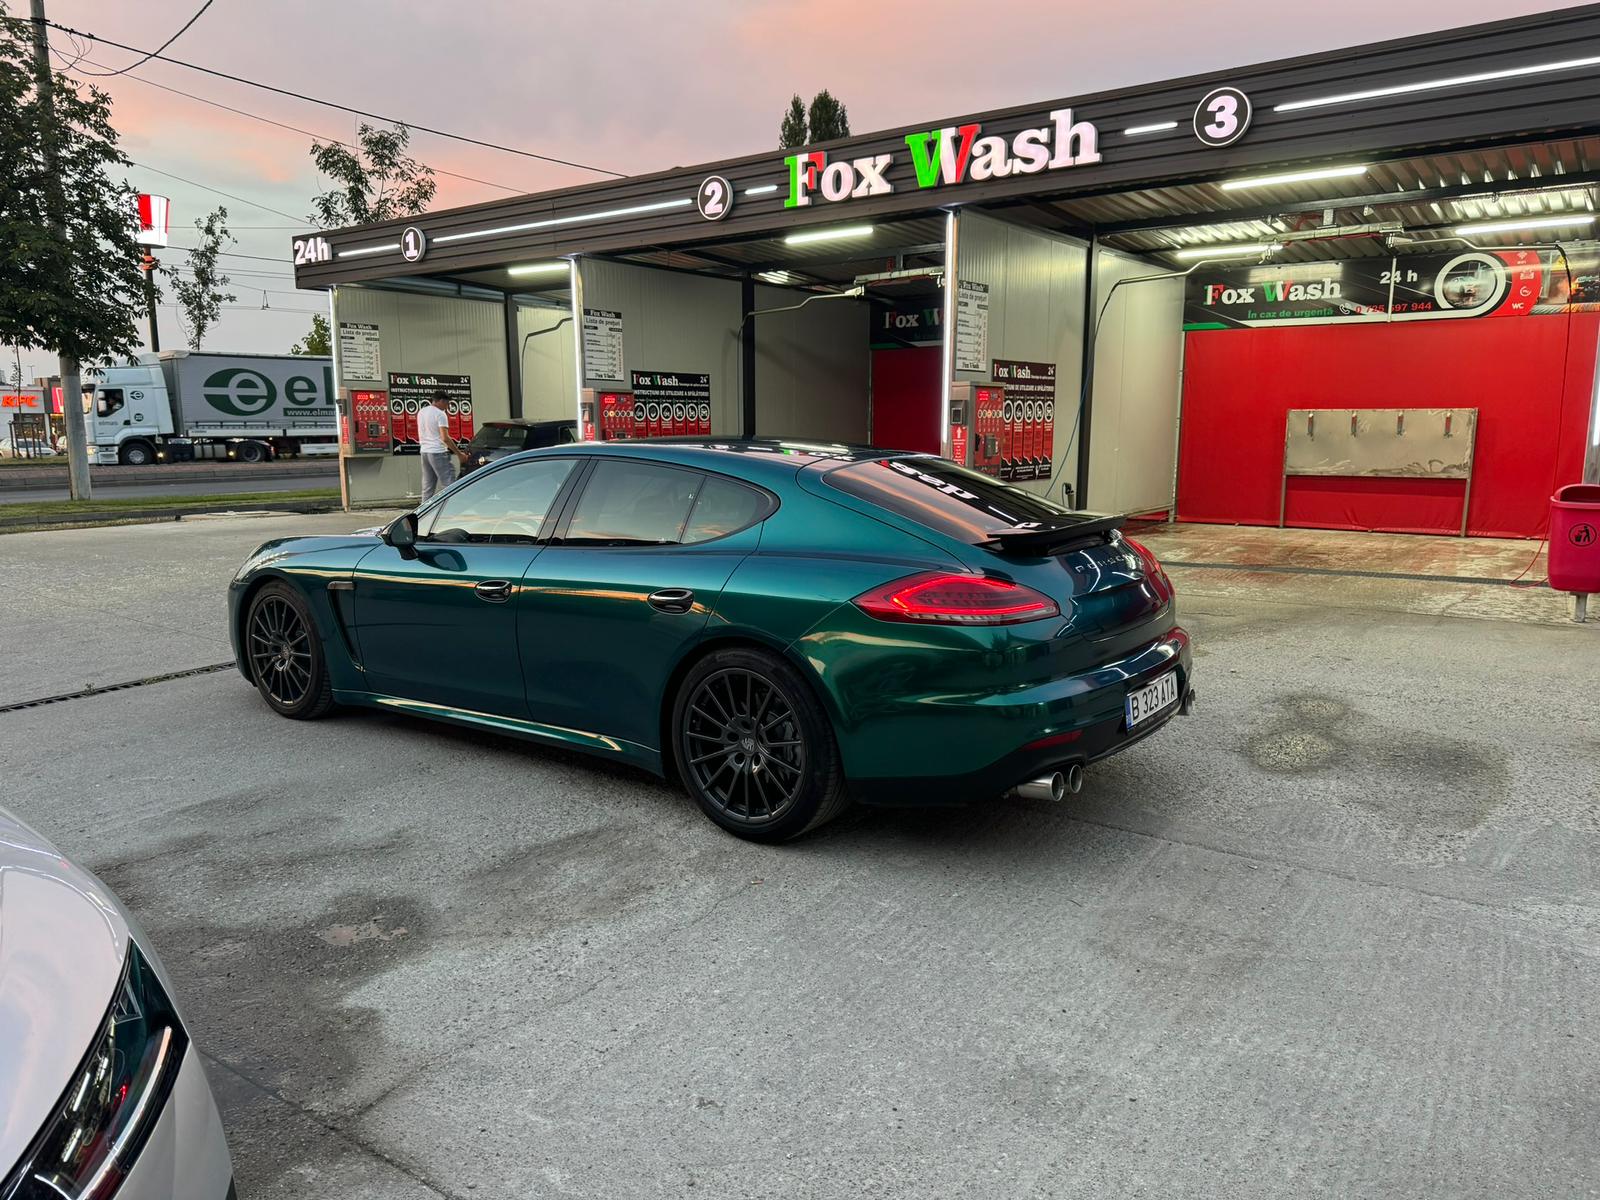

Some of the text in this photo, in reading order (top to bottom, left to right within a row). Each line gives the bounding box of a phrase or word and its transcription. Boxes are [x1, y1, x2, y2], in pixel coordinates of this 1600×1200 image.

[1204, 95, 1238, 139] 3
[784, 108, 1103, 208] Fox Wash
[705, 181, 723, 215] 2
[294, 236, 333, 265] 24h
[405, 231, 418, 258] 1
[1379, 269, 1418, 284] 24 h
[1203, 278, 1343, 306] Fox Wash
[1259, 310, 1278, 318] caz
[1280, 309, 1292, 317] de
[1411, 301, 1432, 311] 944
[1511, 302, 1525, 310] WC
[883, 311, 919, 329] Fox
[994, 363, 1031, 379] Fox Wash
[390, 374, 409, 385] Fox
[410, 375, 438, 386] Wash
[633, 374, 651, 385] Fox
[652, 375, 679, 386] Wash
[2, 394, 38, 407] KFC
[1131, 695, 1140, 721] B
[1142, 685, 1159, 714] 323
[1161, 675, 1176, 705] ATA
